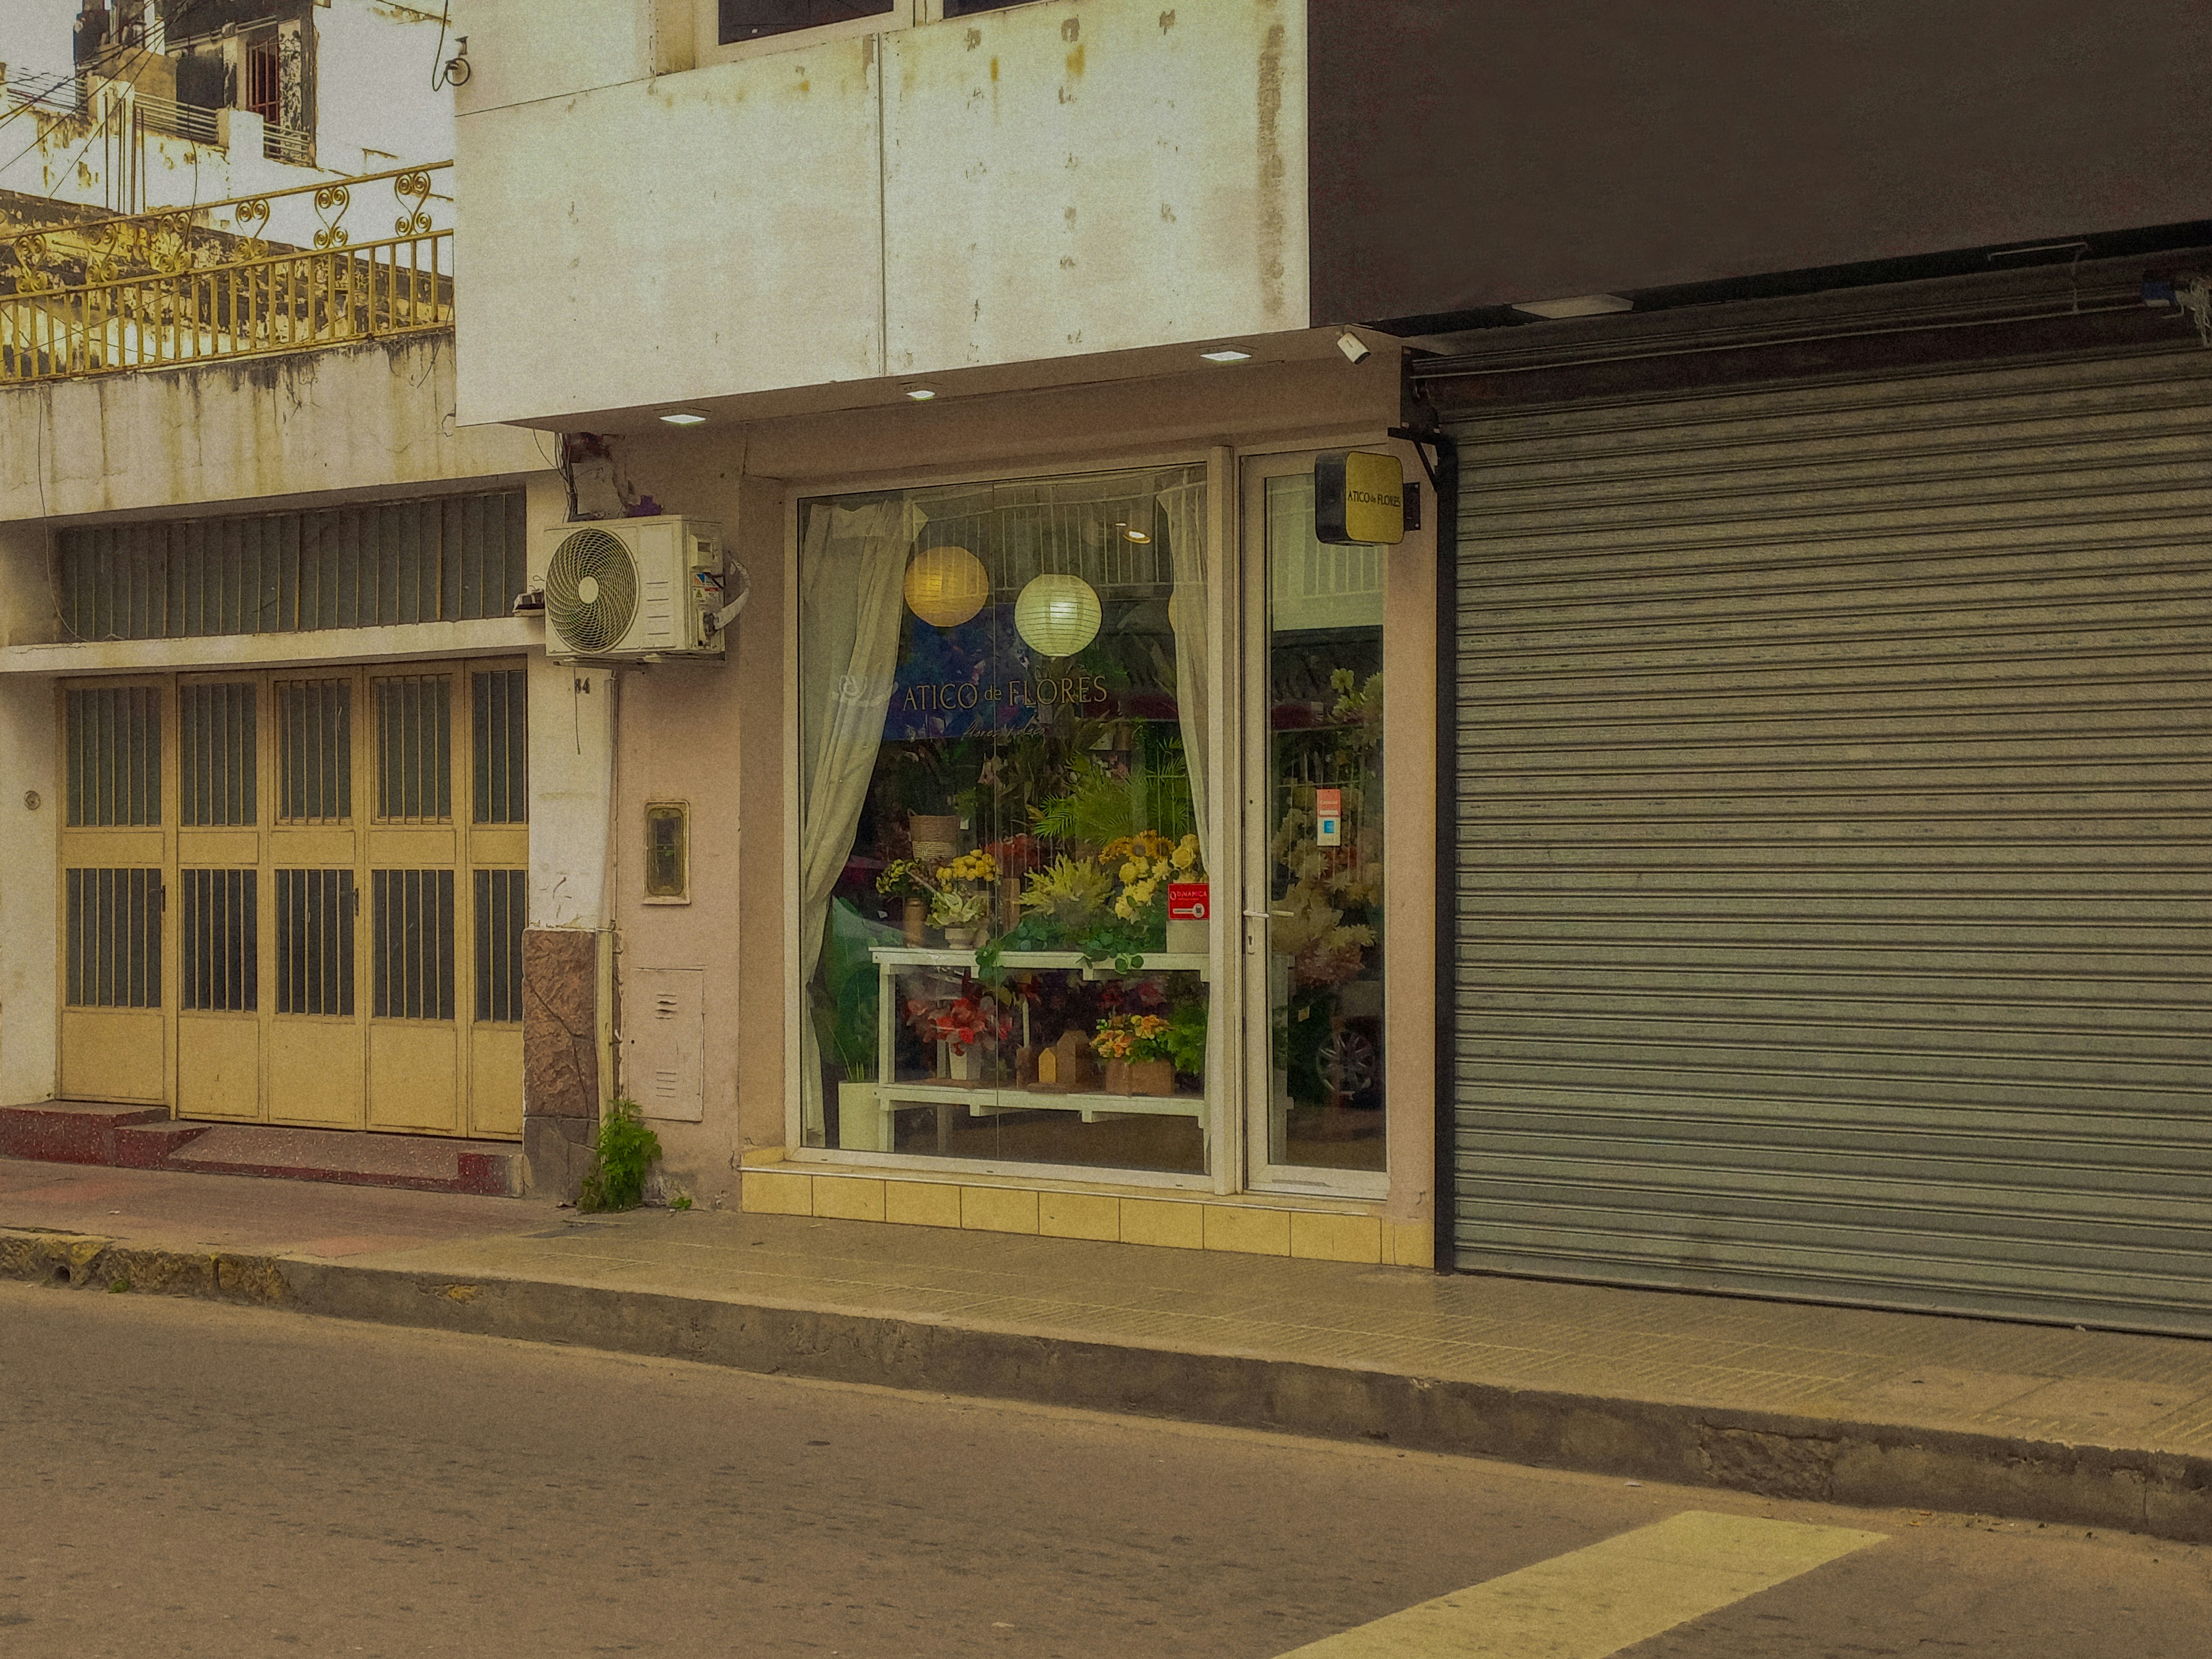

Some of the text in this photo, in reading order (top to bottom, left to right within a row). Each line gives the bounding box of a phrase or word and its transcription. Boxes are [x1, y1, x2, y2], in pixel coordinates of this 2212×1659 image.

[1348, 490, 1370, 503] ATICO
[1377, 494, 1401, 507] FLORES
[903, 676, 1107, 711] ATICO de FLORES
